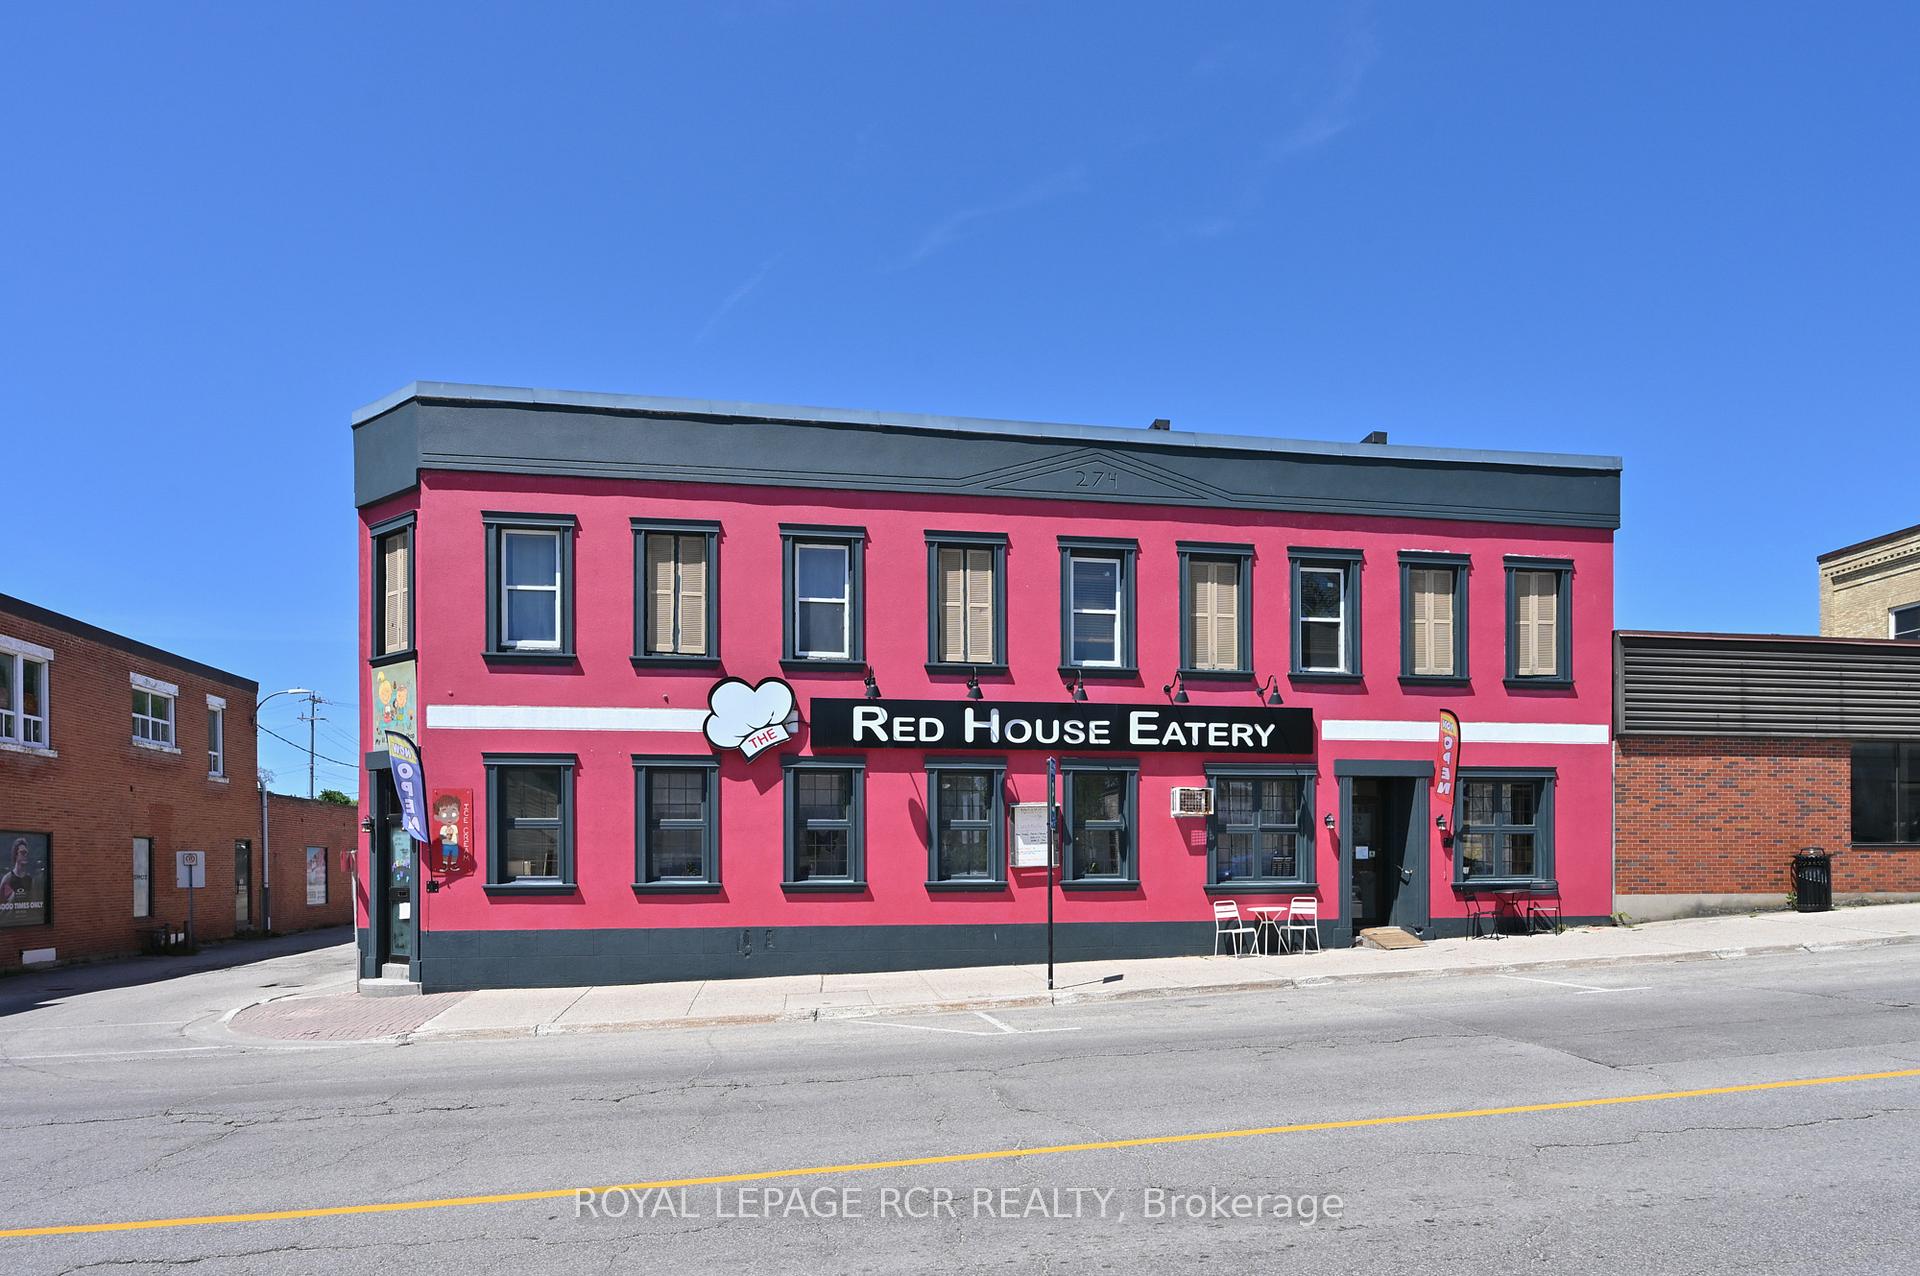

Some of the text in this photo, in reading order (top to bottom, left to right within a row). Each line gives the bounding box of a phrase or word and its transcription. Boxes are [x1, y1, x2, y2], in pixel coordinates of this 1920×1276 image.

[1075, 470, 1119, 489] 274
[748, 728, 778, 749] THE
[852, 705, 1276, 747] RED HOUSE EATERY
[462, 828, 470, 862] CREAM
